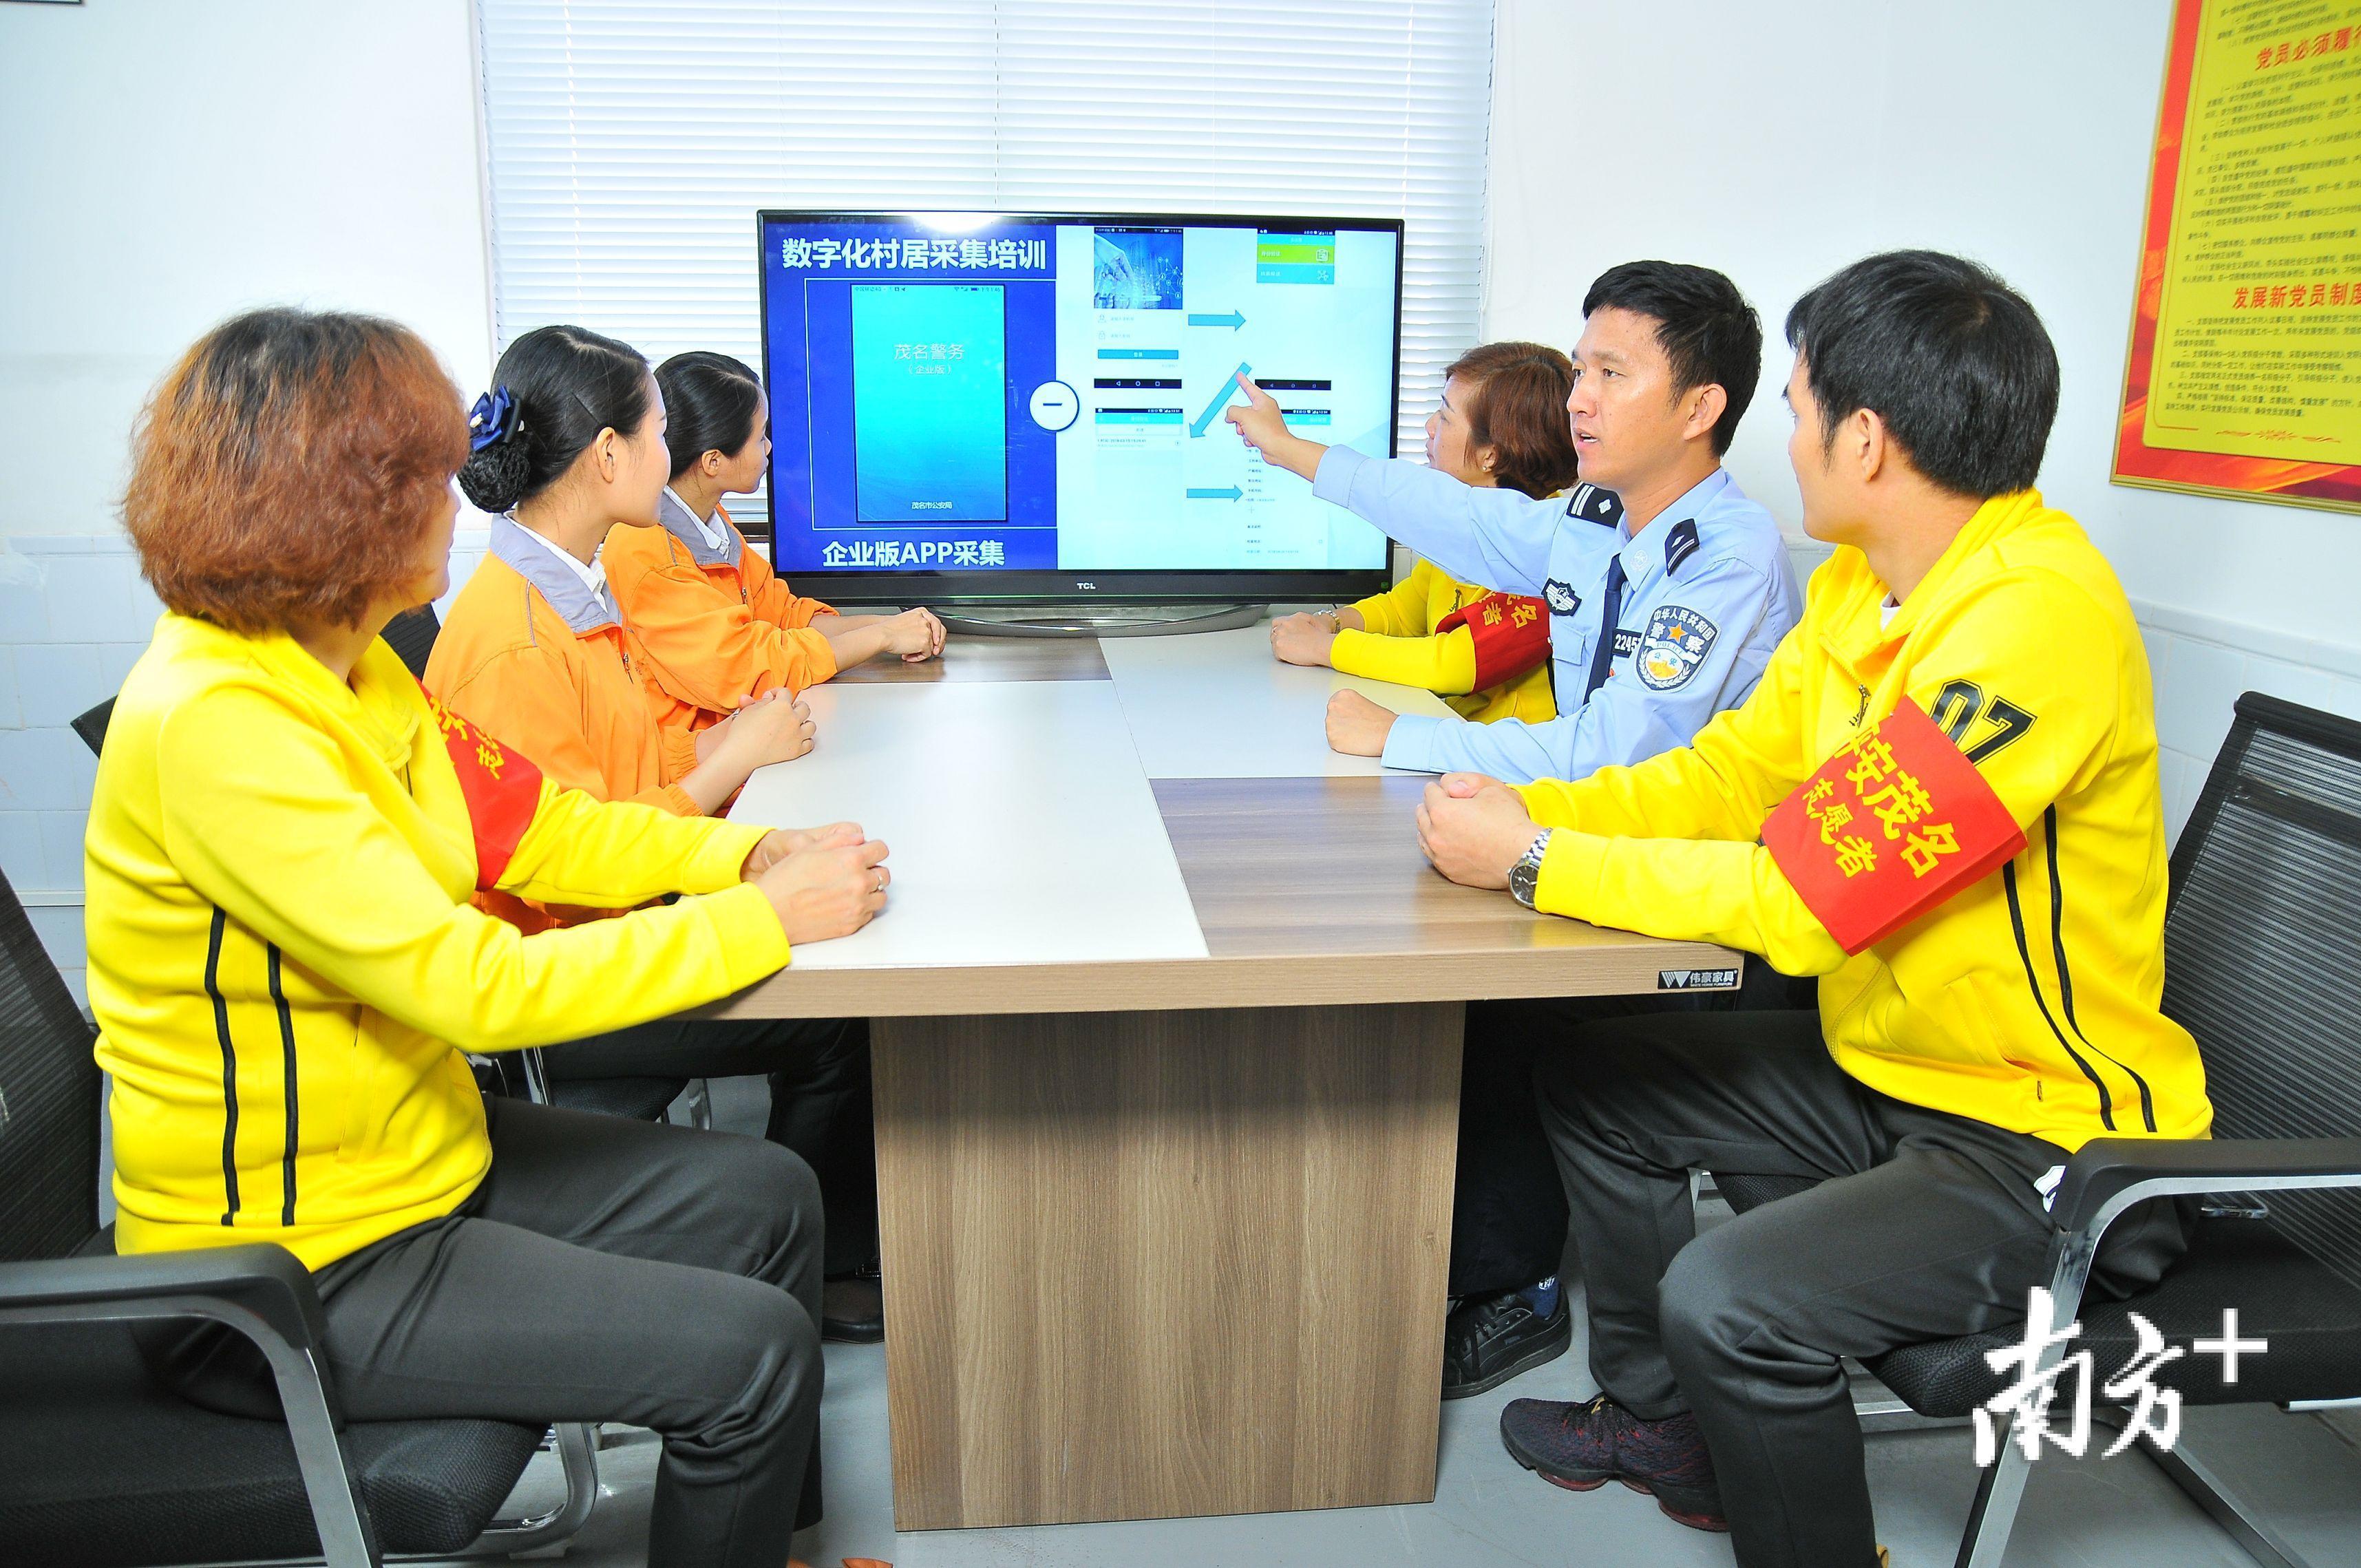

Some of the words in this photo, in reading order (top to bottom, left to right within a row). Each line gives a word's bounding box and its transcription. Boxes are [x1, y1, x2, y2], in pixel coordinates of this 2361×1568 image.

[782, 237, 1046, 270] 数字化村居采集培训
[893, 343, 965, 361] 茂名警务
[911, 501, 953, 509] 茂名市公安局
[822, 540, 1005, 568] 企业版APP采集
[1653, 607, 1716, 642] 中华人民共和国
[1929, 678, 2038, 767] 07
[1801, 778, 1878, 878] 志愿者
[1690, 971, 1734, 984] 伟豪家具
